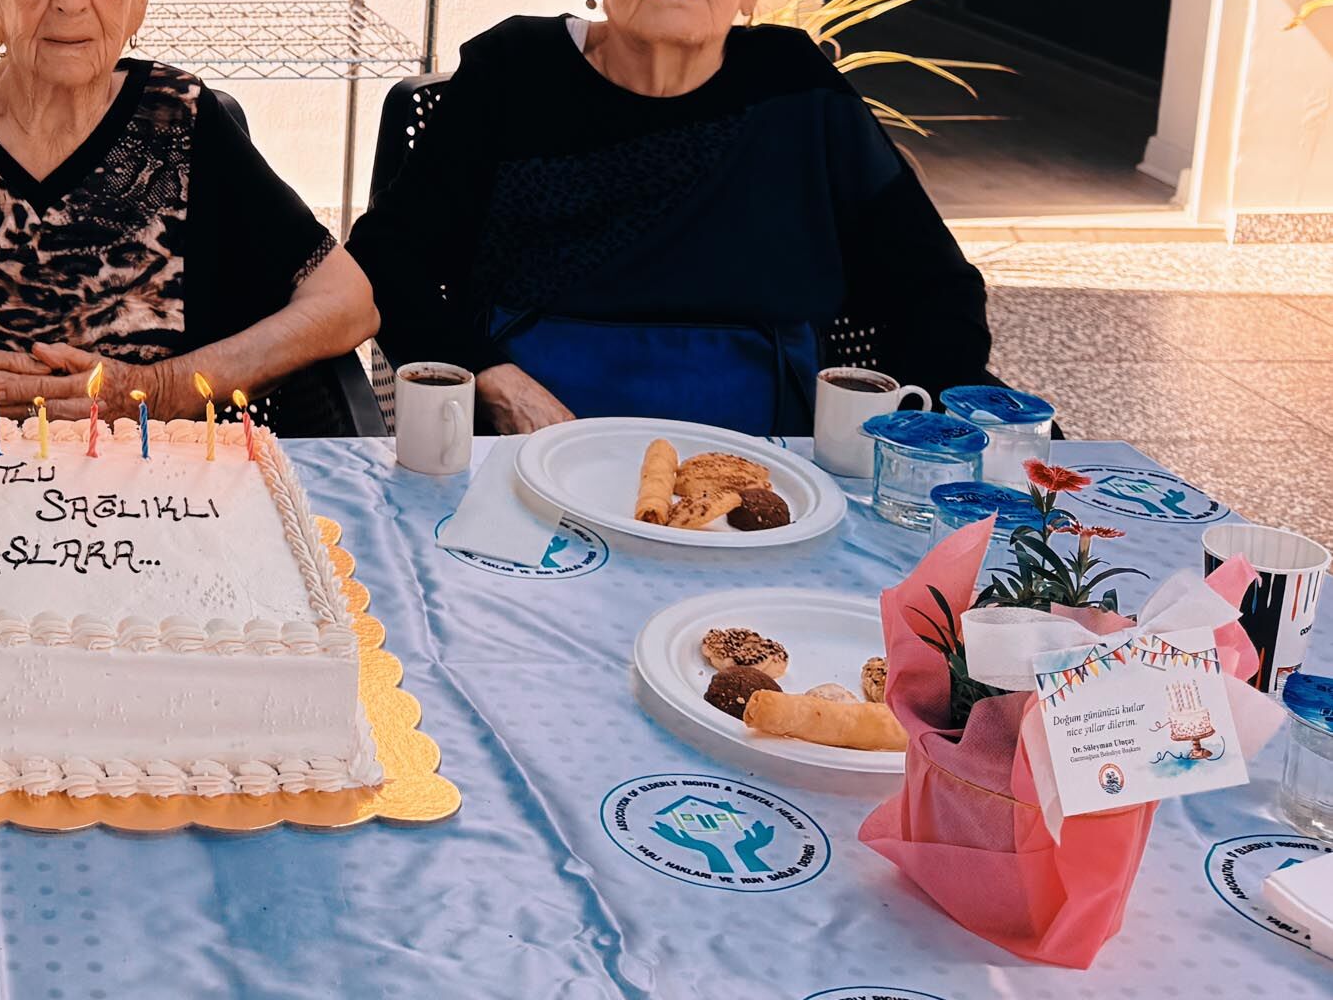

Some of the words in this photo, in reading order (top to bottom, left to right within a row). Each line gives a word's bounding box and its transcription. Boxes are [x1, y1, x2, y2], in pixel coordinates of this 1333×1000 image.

[36, 489, 220, 528] SAĞLIKLI
[1053, 714, 1082, 726] Doğum
[1083, 706, 1120, 722] gününüzü
[1122, 702, 1145, 714] kutlar
[1066, 727, 1082, 737] nice
[1084, 722, 1105, 736] yıllar
[1107, 719, 1137, 731] dilerim.
[1072, 746, 1082, 754] Dr.
[1083, 742, 1113, 752] Süleyman
